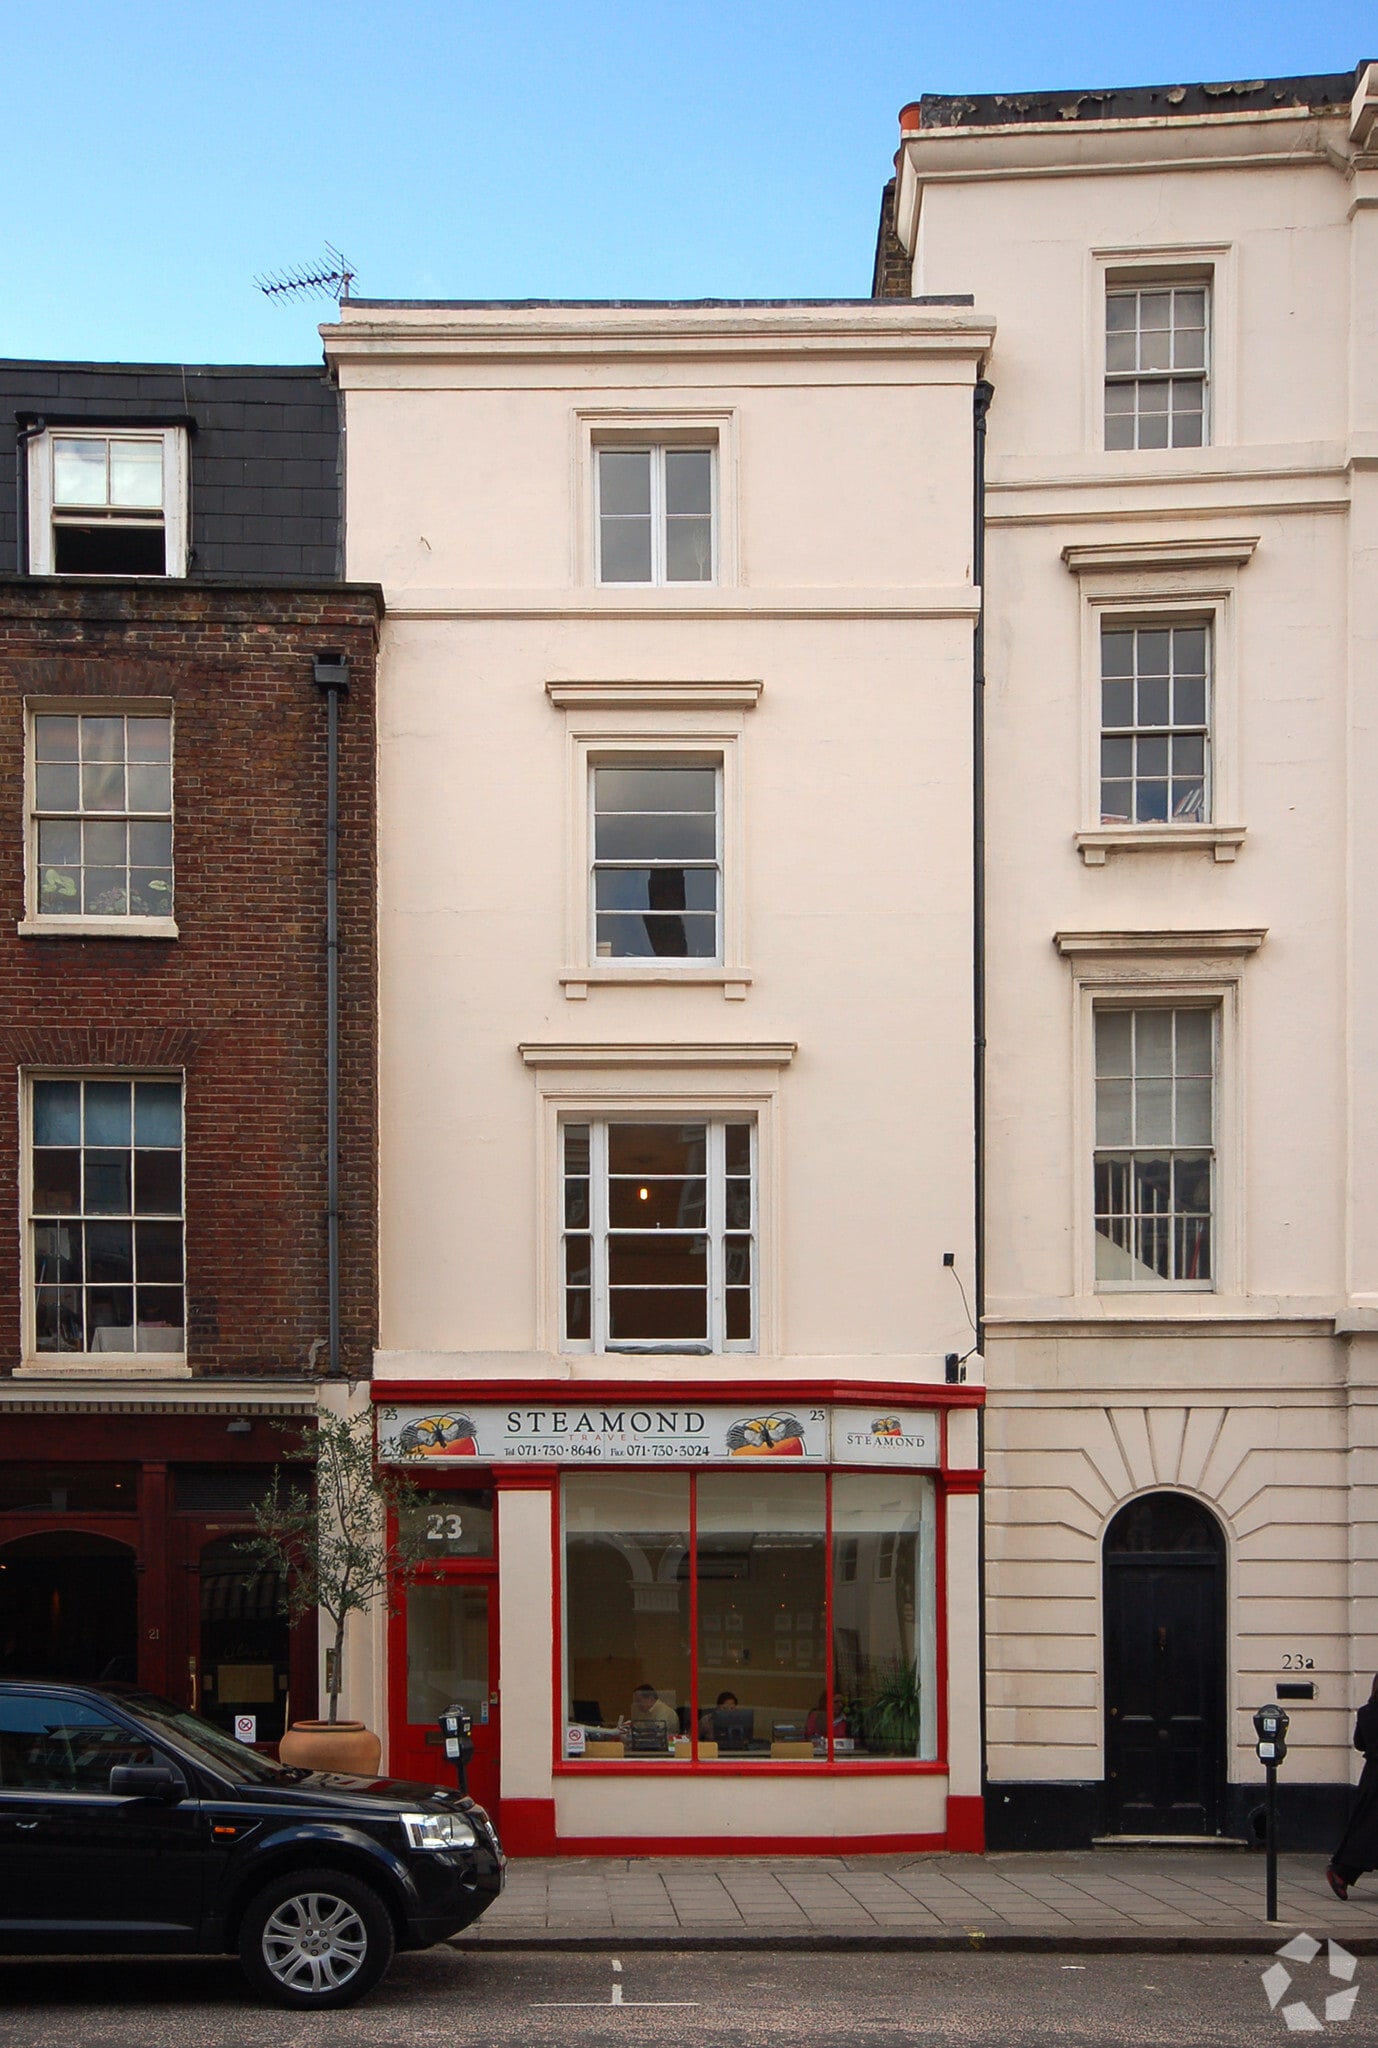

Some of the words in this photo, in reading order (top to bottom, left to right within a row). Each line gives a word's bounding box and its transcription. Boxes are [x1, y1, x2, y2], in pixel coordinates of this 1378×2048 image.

[507, 1411, 705, 1433] STEAMOND
[810, 1409, 825, 1421] 23
[847, 1434, 925, 1448] STEAMOND
[427, 1514, 462, 1539] 23
[148, 1628, 160, 1640] 21
[1282, 1654, 1315, 1669] 23a
